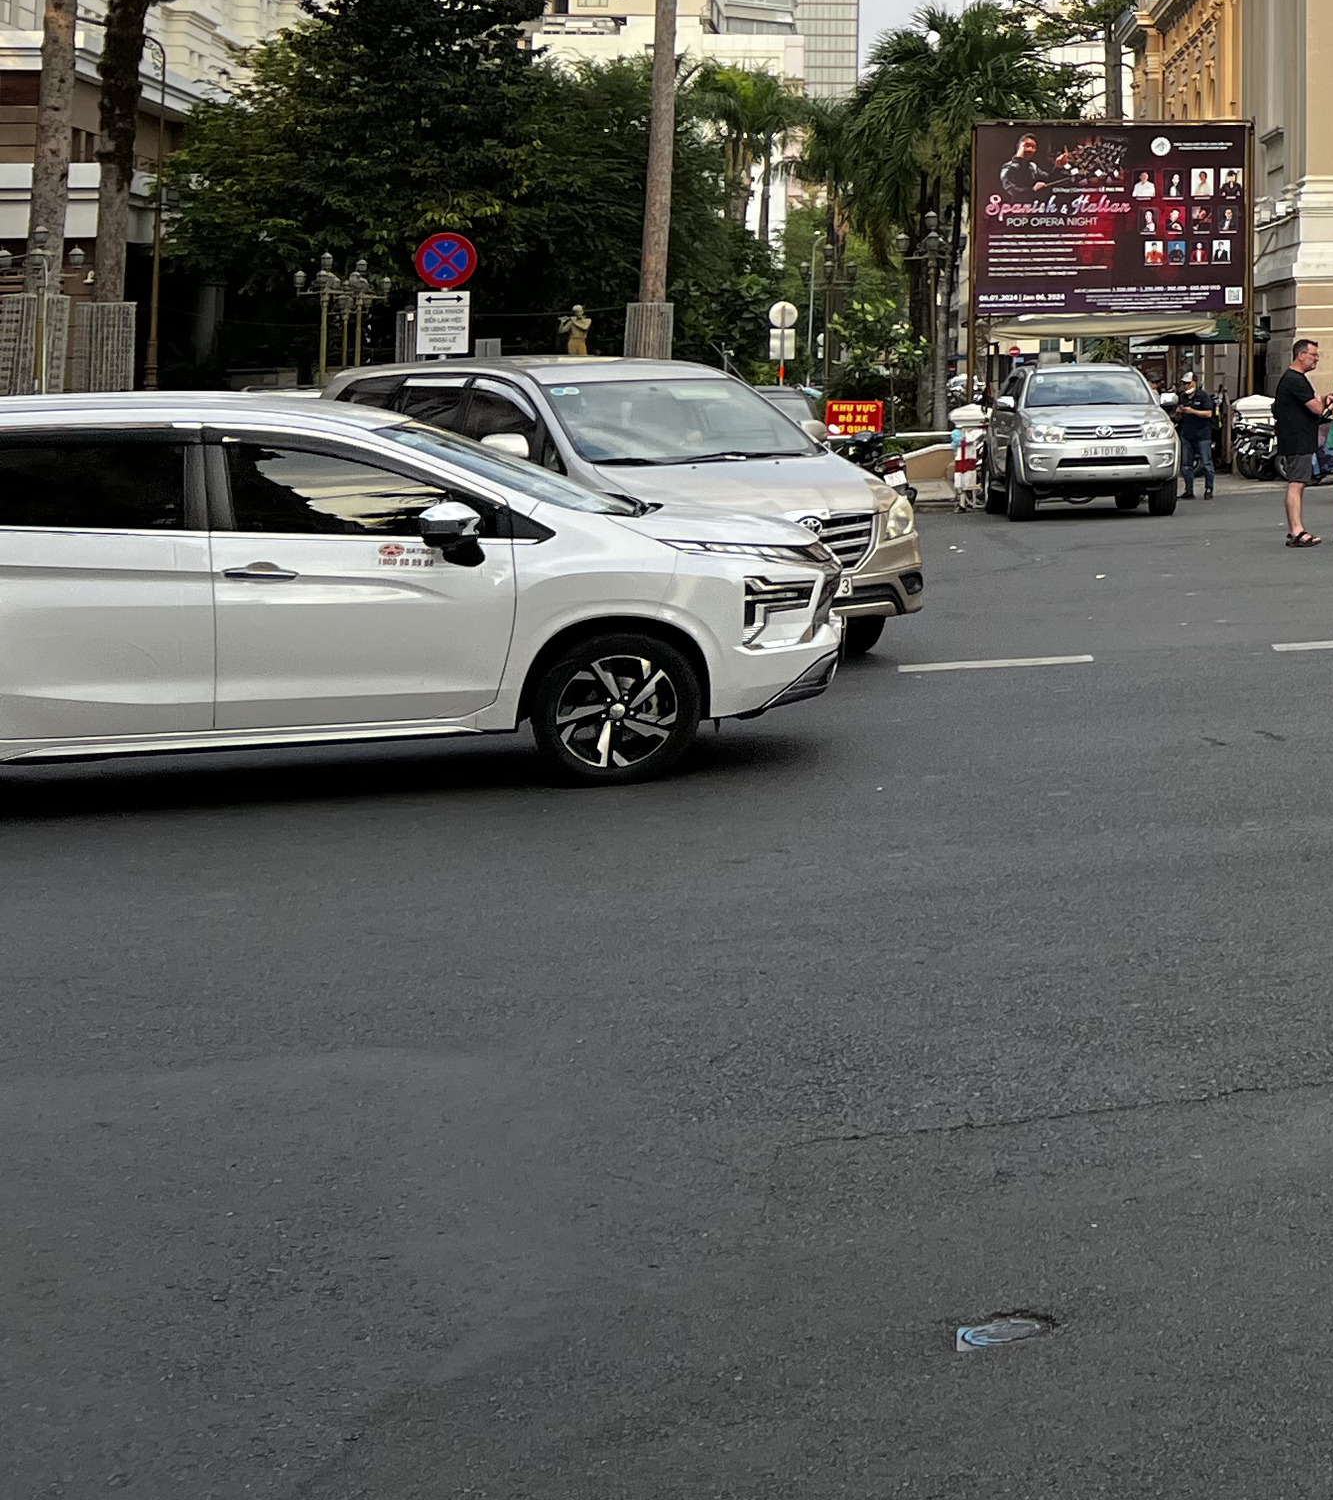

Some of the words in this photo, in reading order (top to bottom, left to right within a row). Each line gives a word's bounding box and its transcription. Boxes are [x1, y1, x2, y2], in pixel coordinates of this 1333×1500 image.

[985, 194, 1058, 221] Spanish
[1060, 204, 1068, 214] &
[1070, 194, 1132, 215] Italian
[1006, 217, 1029, 227] POP
[1030, 217, 1065, 227] OPERA
[1066, 216, 1099, 226] NIGHT
[832, 403, 854, 412] KHU
[855, 414, 869, 423] XE
[842, 578, 850, 594] 3
